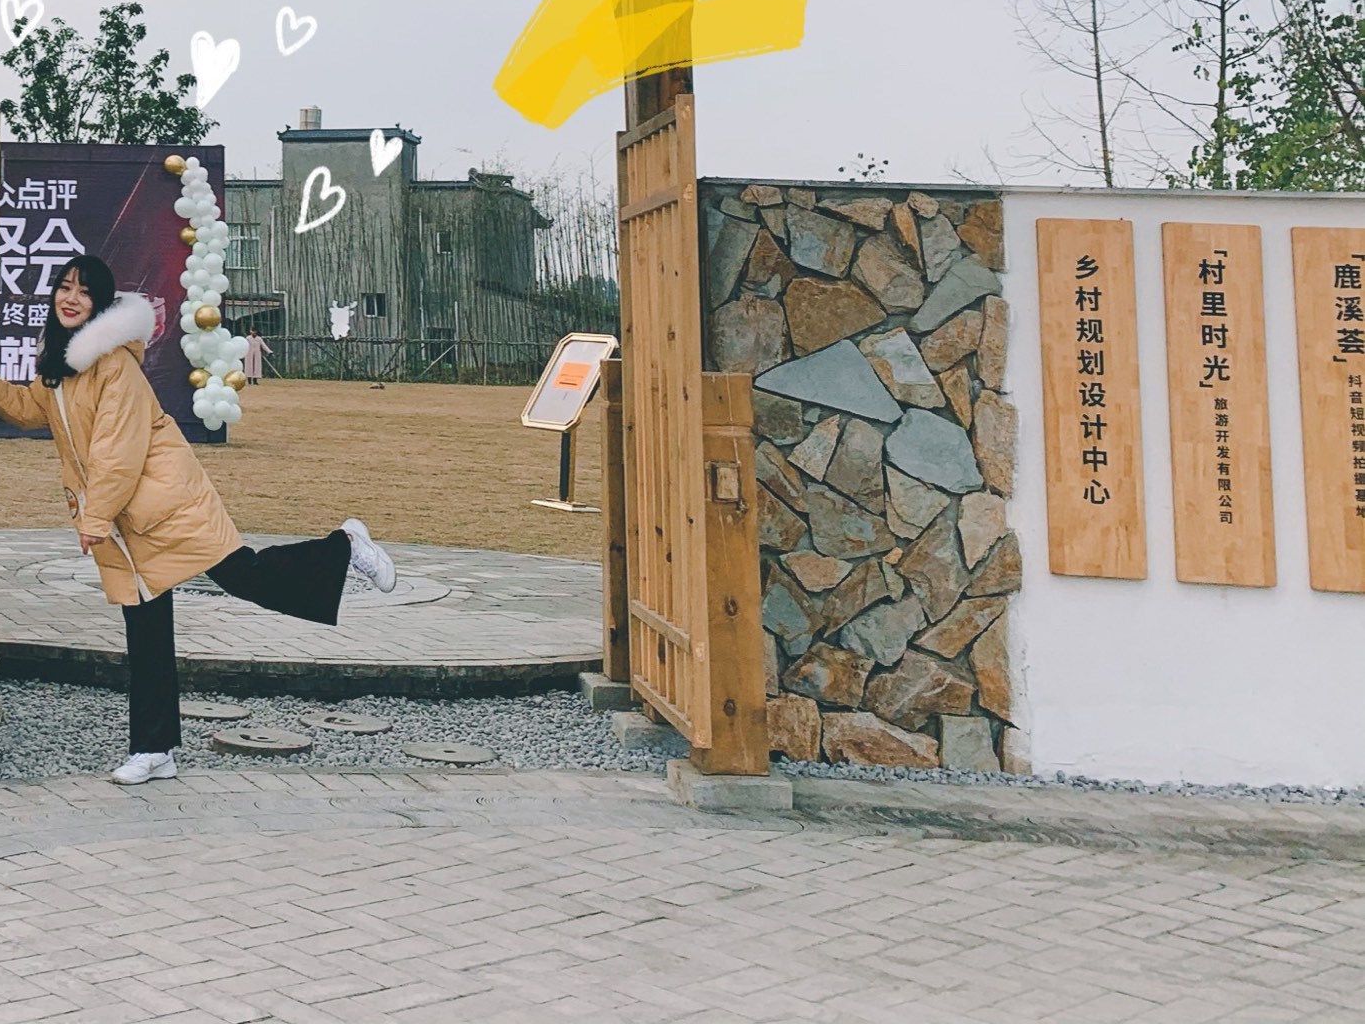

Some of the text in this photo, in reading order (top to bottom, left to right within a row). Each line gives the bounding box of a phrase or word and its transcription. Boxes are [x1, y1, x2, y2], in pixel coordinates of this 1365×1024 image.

[1074, 254, 1111, 506] 乡村规划设计中心
[1214, 397, 1233, 525] 旅游开发有限公司
